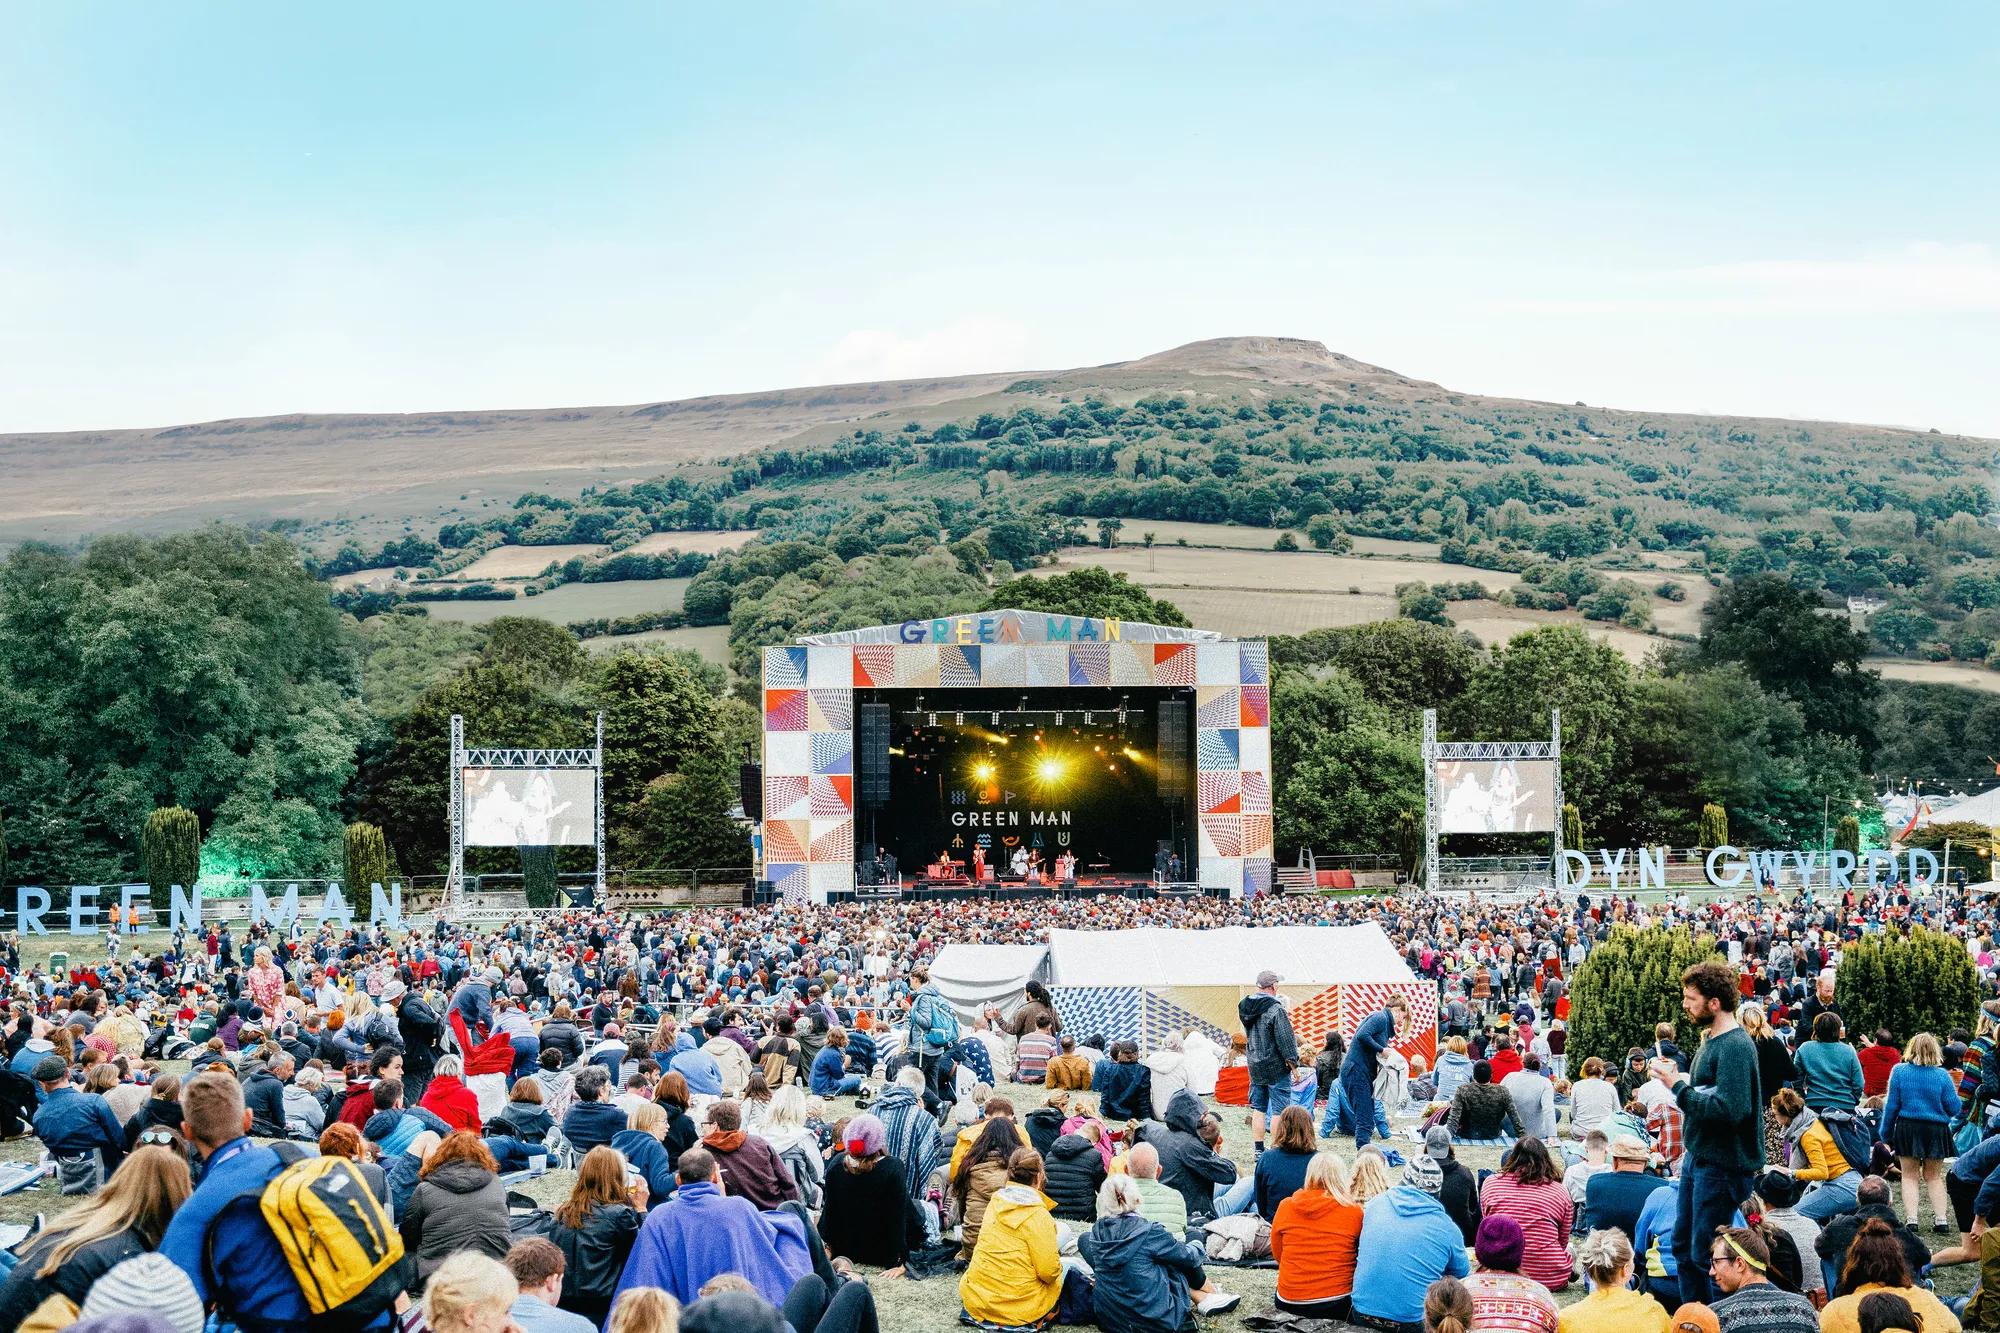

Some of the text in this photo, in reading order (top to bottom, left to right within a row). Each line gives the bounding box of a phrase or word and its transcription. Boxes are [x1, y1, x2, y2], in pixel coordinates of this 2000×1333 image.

[900, 617, 1121, 644] GREEN MAN
[951, 810, 1071, 827] GREEN MAN
[1560, 847, 1666, 890] DYN
[1705, 845, 1939, 892] GWYRDD
[0, 883, 402, 936] REEN MAN
